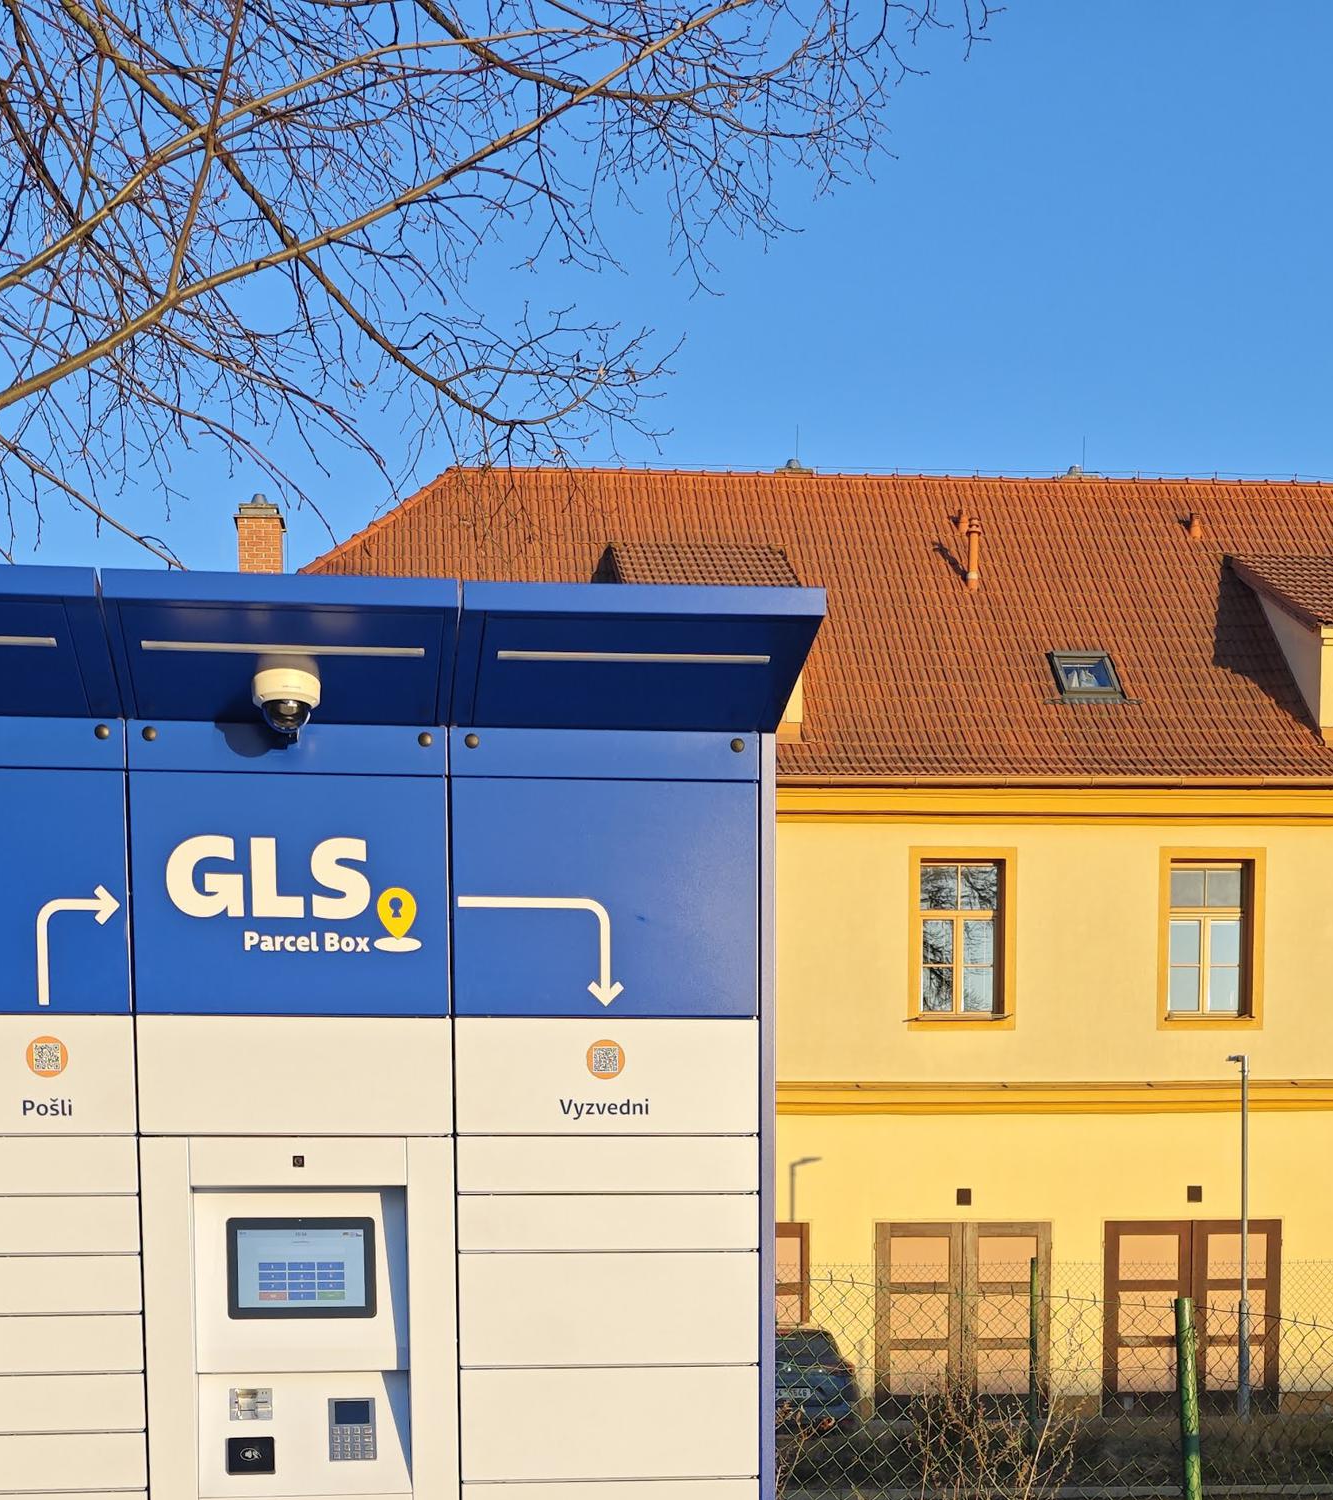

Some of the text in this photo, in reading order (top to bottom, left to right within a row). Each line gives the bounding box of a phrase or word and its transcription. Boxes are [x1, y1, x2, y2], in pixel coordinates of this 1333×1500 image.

[166, 834, 371, 920] GLS
[243, 930, 371, 953] Parcel Box
[22, 1097, 73, 1117] Pošli
[559, 1098, 650, 1121] Vyzvedni
